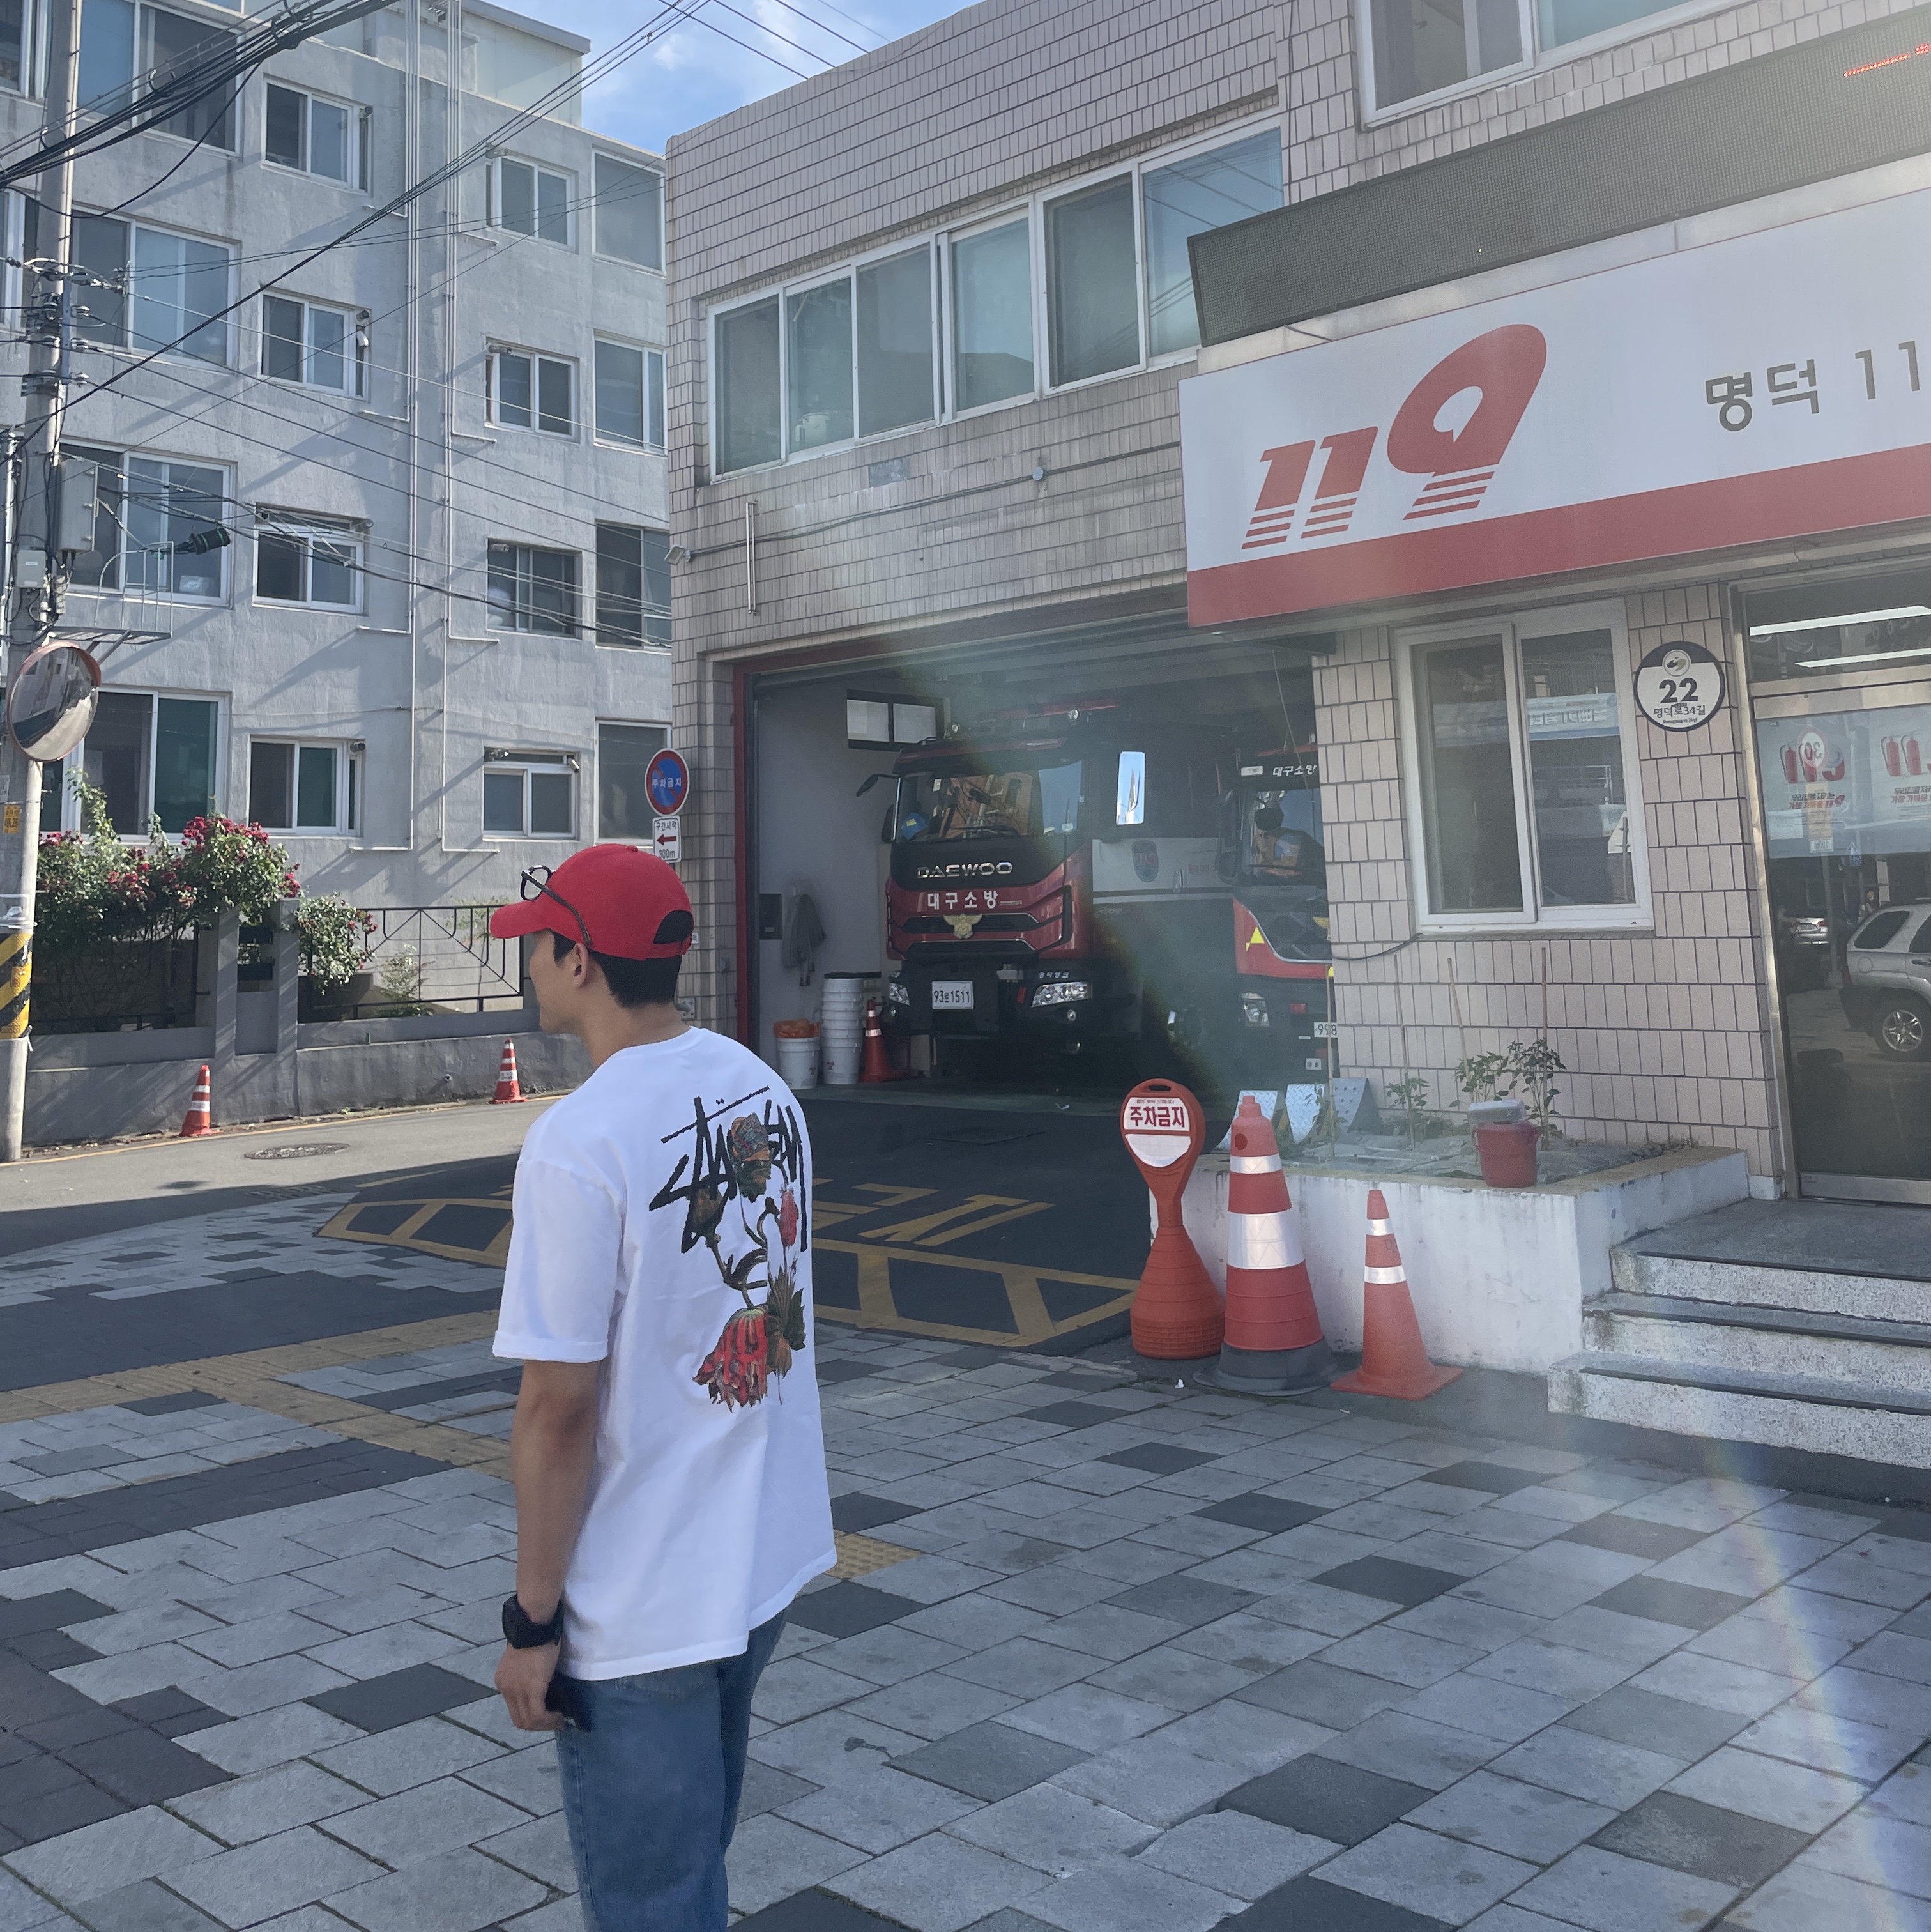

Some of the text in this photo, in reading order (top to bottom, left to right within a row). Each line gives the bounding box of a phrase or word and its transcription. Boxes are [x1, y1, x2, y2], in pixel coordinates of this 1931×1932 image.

[1705, 358, 1820, 433] 명덕
[1241, 323, 1547, 550] 119
[1659, 678, 1698, 703] 22
[1654, 704, 1705, 718] 명덕로34길
[652, 777, 682, 788] 주차금지
[656, 820, 676, 831] 구간시작
[917, 861, 1013, 878] DAEWOO
[927, 890, 998, 910] 대구소방
[1130, 1106, 1185, 1128] 주차금지
